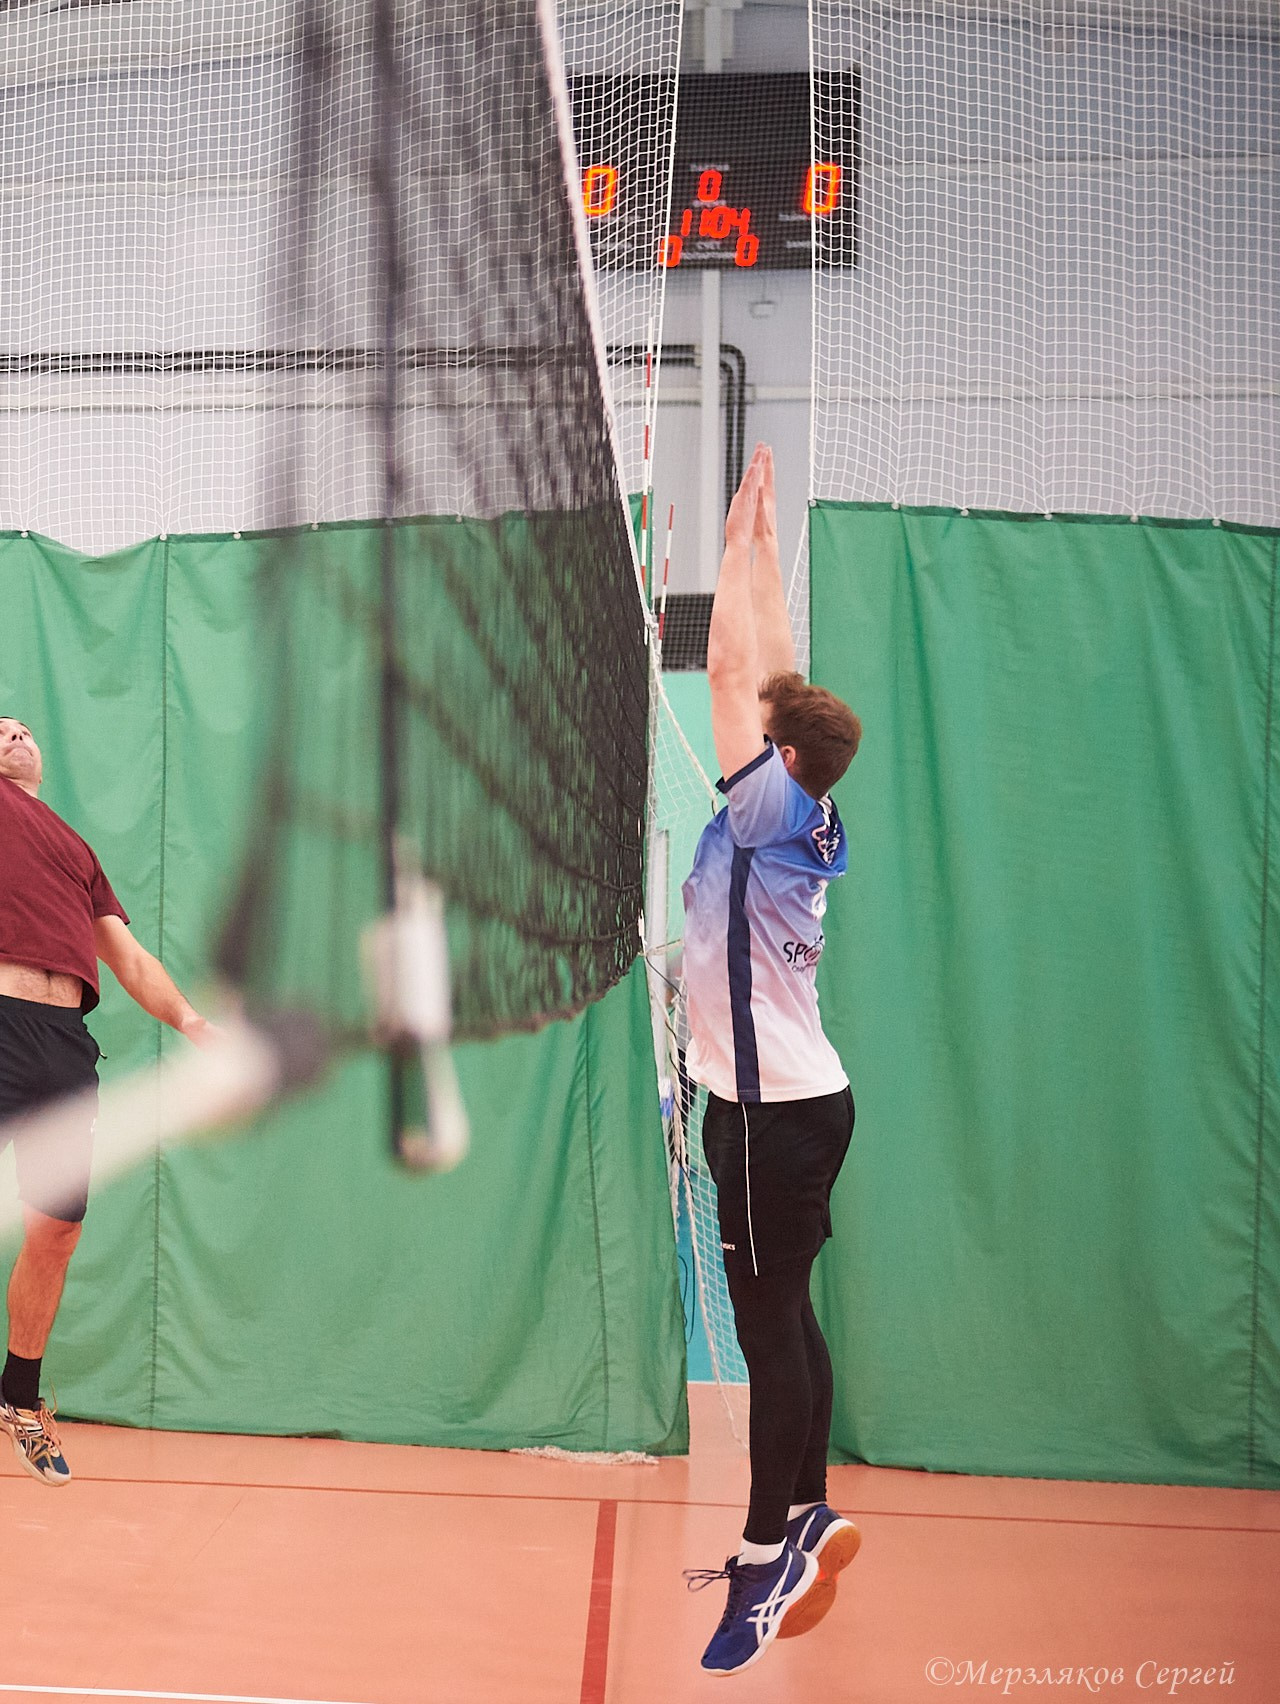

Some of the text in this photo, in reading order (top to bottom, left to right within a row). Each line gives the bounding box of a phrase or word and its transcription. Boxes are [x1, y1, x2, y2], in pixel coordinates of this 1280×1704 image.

[583, 165, 618, 216] 0
[803, 161, 840, 214] 0
[735, 234, 760, 267] 0
